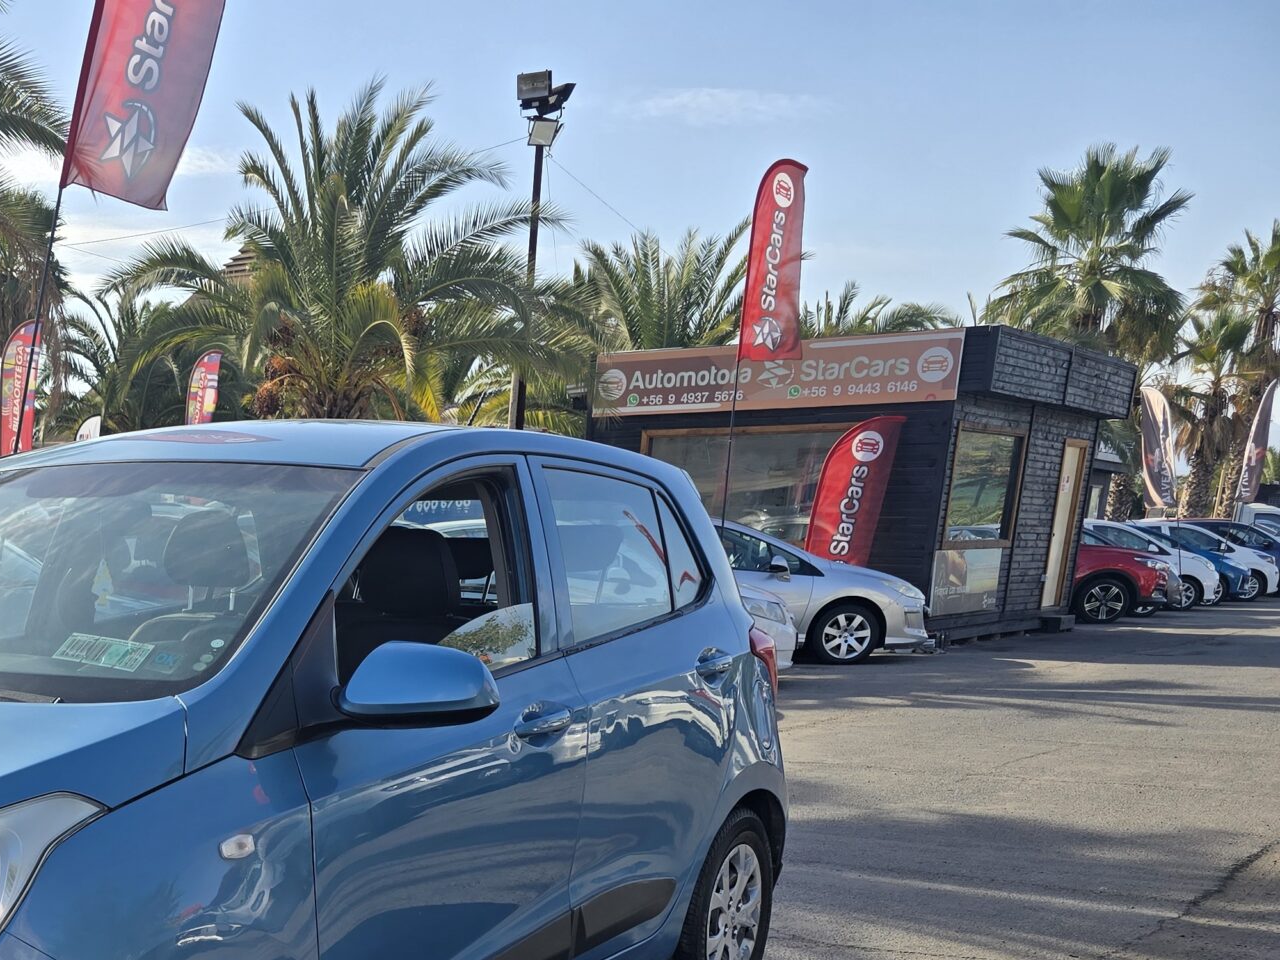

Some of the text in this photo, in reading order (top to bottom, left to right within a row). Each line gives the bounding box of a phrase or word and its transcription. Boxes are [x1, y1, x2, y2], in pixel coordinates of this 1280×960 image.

[761, 210, 786, 312] StarCars
[12, 344, 24, 432] BILBAORTEGA
[629, 356, 910, 390] Automotora StarCars
[642, 389, 744, 405] +56 9 4937 5676
[803, 380, 918, 397] +56 9 9443 6146
[829, 465, 869, 556] StarCars
